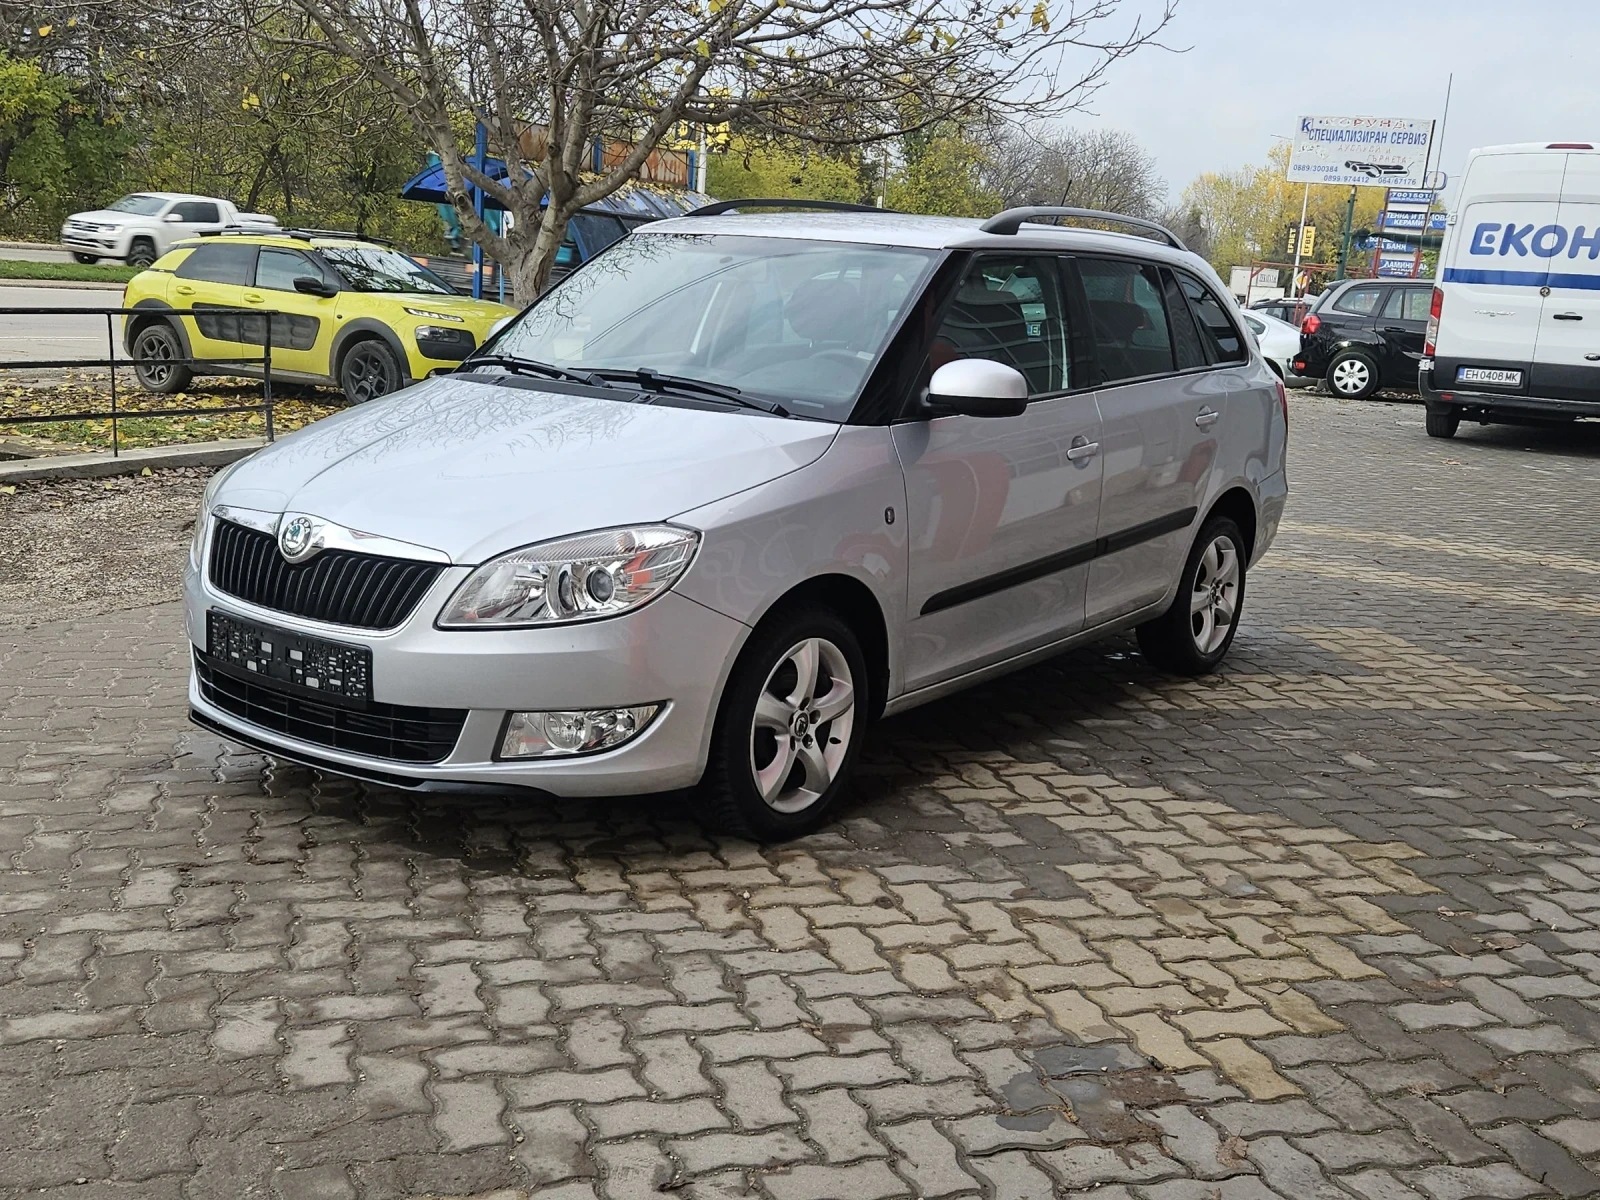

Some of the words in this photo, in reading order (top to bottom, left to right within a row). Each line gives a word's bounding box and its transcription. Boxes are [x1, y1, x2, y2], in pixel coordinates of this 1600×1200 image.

[1308, 128, 1388, 143] СПЕЦИАЛИЗИРАН
[1391, 131, 1428, 145] СЕРВИЗ
[1287, 228, 1297, 254] EFBET
[1303, 229, 1312, 254] EFBET
[1480, 371, 1503, 381] 0408
[1505, 372, 1519, 382] MK
